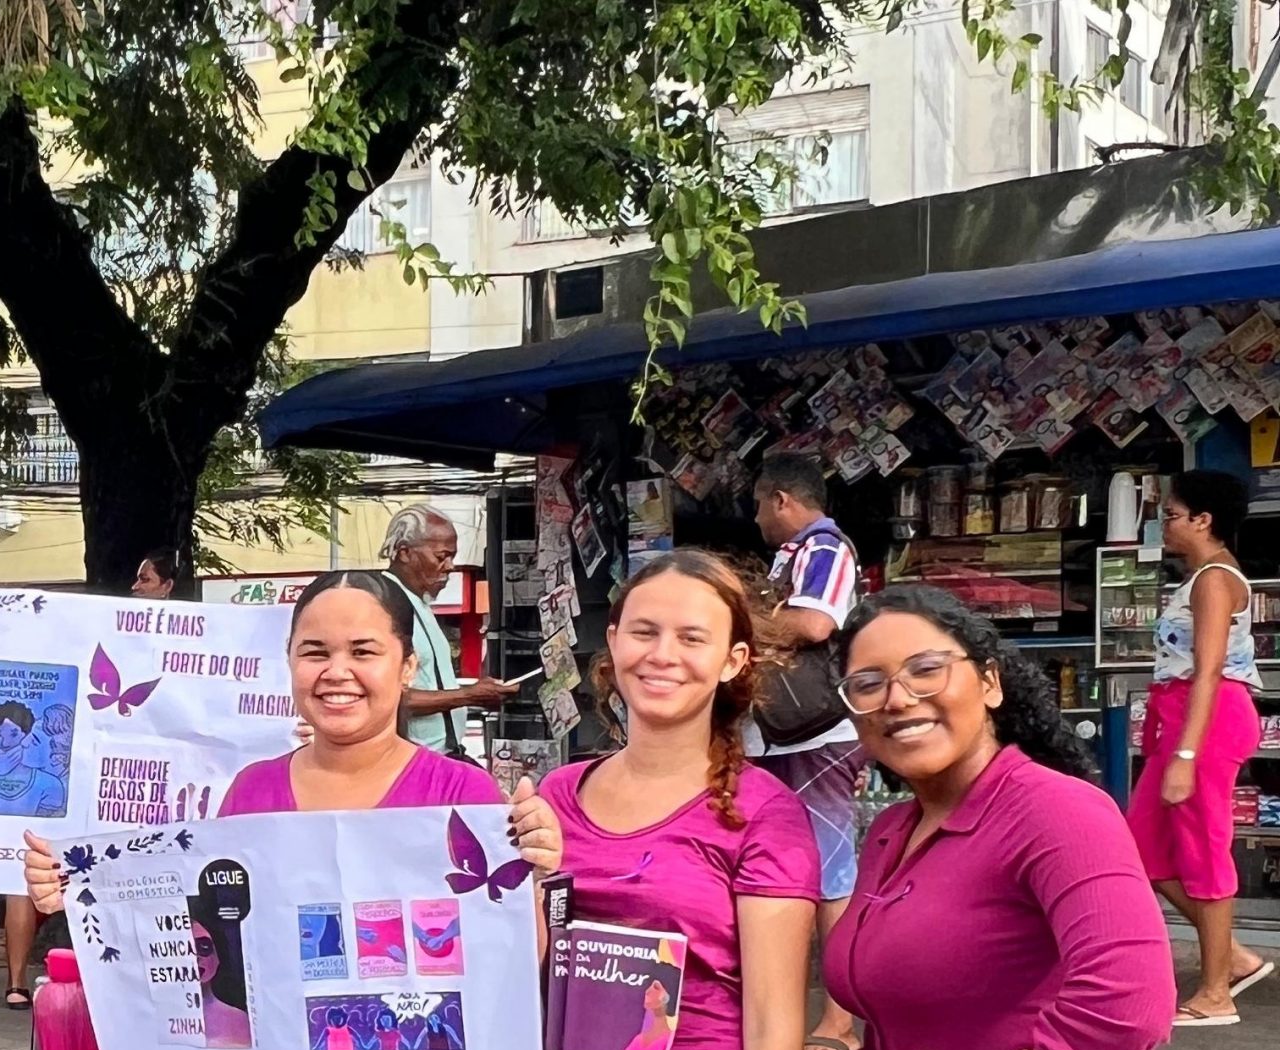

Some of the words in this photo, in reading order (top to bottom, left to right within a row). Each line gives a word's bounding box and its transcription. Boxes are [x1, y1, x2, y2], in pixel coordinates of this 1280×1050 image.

[116, 607, 152, 633] VOCÊ
[155, 608, 165, 634] É
[167, 613, 205, 637] MAIS
[162, 651, 205, 675] FORTE
[208, 655, 229, 676] DO
[233, 656, 261, 681] QUE
[101, 757, 170, 782] DENUNCIE
[99, 778, 145, 802] CASOS
[150, 782, 167, 803] DE
[205, 870, 244, 886] LIGUE
[149, 940, 197, 958] NUNCA
[576, 940, 660, 963] OUVIDORIA
[575, 958, 650, 986] mulher
